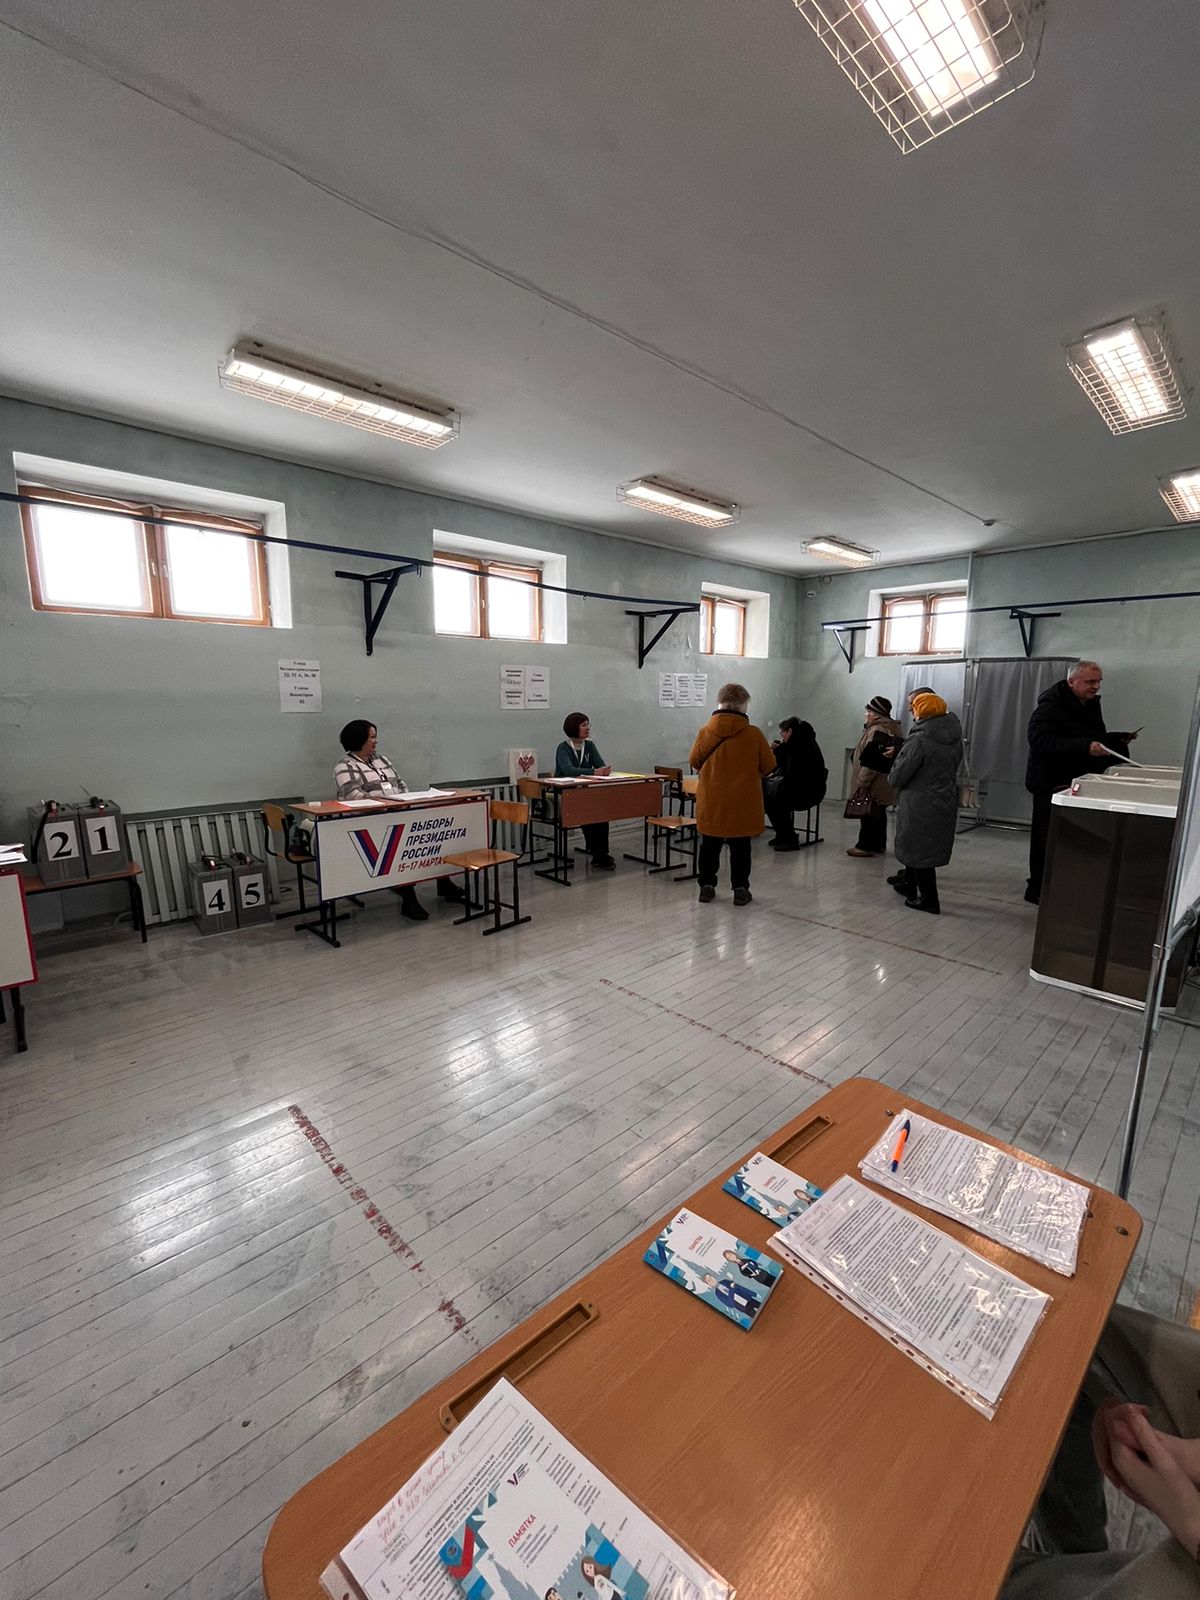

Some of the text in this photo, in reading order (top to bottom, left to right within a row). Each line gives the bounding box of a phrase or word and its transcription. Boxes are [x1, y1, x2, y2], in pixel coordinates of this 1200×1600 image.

[410, 817, 454, 833] ВЫБОРЫ
[49, 826, 111, 859] 2 1
[405, 828, 467, 846] ПРЕЗИДЕНТА
[401, 845, 442, 861] РОССИИ
[418, 856, 442, 869] МАРТА
[208, 882, 261, 911] 4 5
[508, 1514, 537, 1548] ПАМЯТКА
